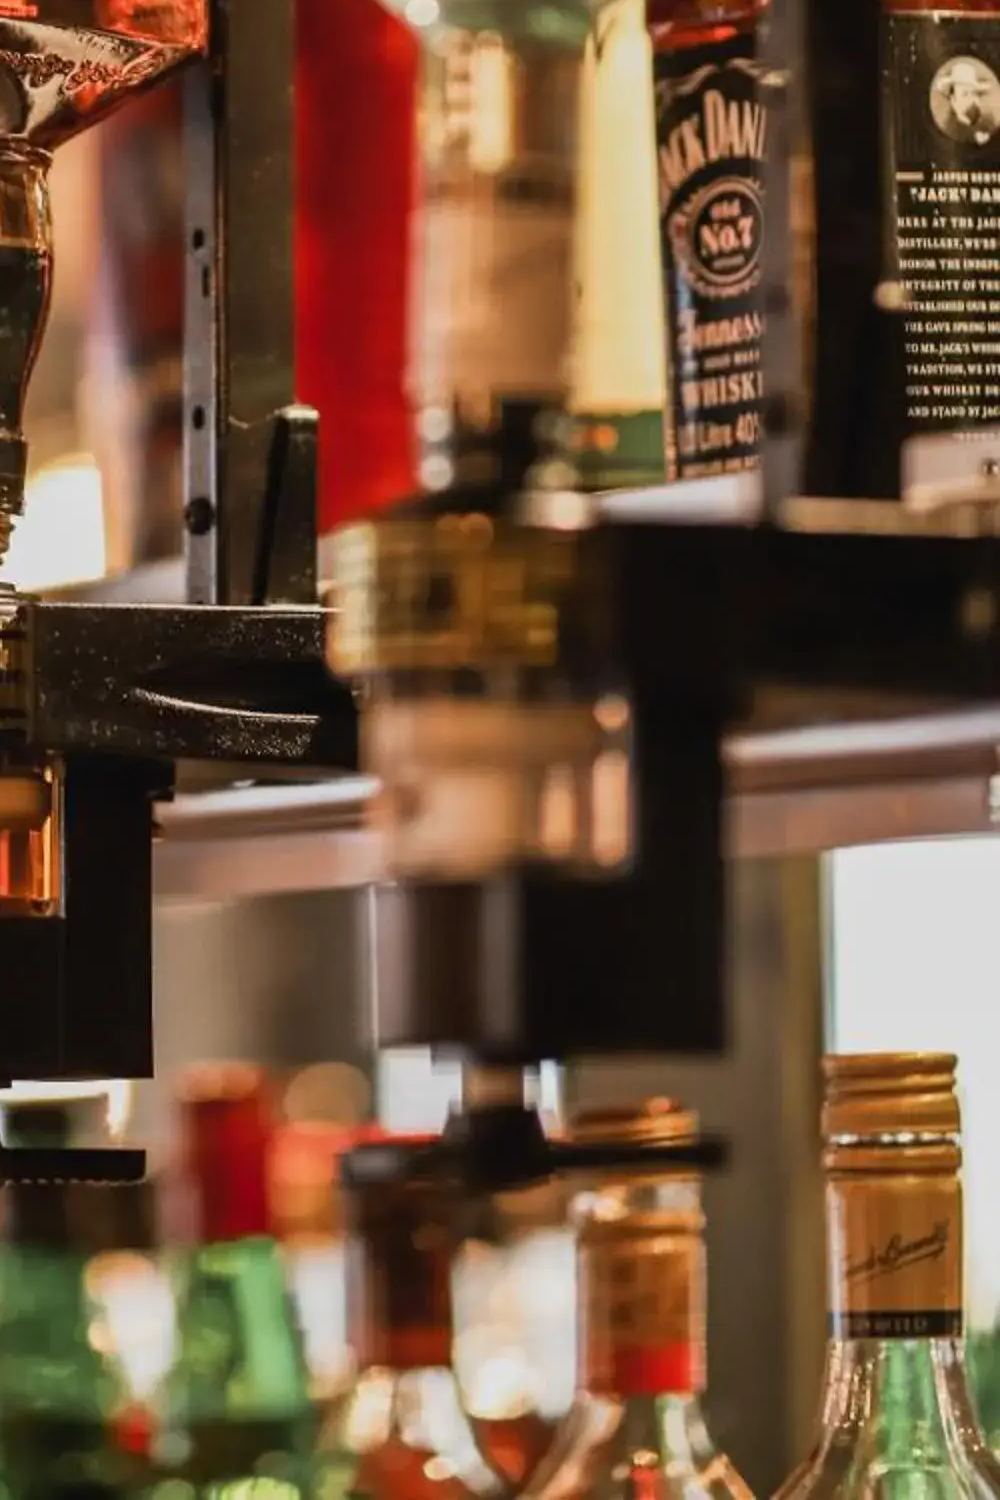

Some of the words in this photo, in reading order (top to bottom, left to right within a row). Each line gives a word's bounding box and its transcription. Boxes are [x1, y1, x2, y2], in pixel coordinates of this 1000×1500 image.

[932, 216, 946, 228] AT
[950, 216, 973, 228] THE
[939, 258, 960, 271] THE
[962, 279, 977, 292] OF
[904, 321, 924, 333] THE
[904, 342, 919, 354] TO
[967, 363, 982, 375] WE
[906, 385, 930, 397] OUR
[932, 385, 981, 397] WHISKEY
[907, 405, 930, 418] AND
[932, 405, 966, 419] STAND
[968, 405, 981, 417] BY
